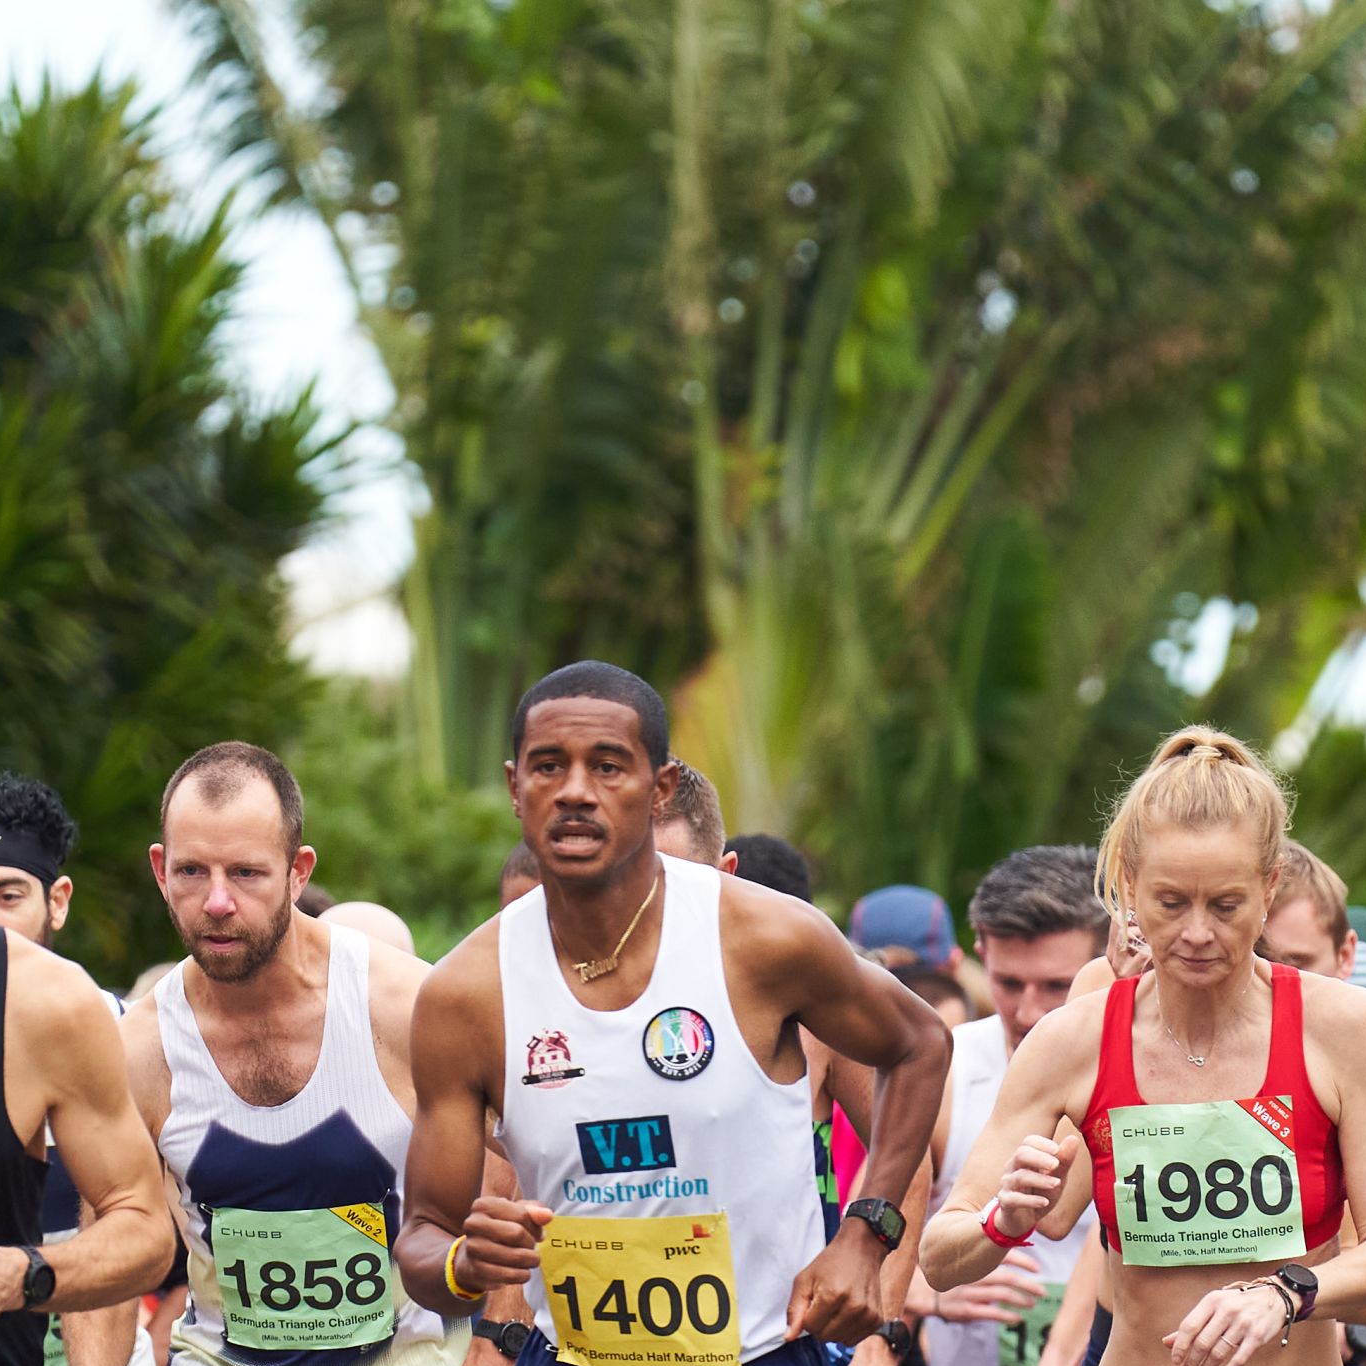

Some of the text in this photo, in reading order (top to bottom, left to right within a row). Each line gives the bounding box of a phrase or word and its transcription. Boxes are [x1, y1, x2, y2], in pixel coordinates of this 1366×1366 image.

[1252, 1101, 1291, 1138] Wave 3
[1122, 1126, 1185, 1138] CHUBB
[586, 1119, 670, 1169] V.T.
[563, 1175, 709, 1203] Construction
[1123, 1154, 1294, 1222] 1980
[221, 1227, 282, 1239] CHUBB
[346, 1209, 382, 1238] Wave 2
[1124, 1224, 1294, 1243] Bermuda Triangle Challenge
[551, 1238, 701, 1260] CHUBB pwc
[1160, 1246, 1258, 1258] (Mile, 10k, Half Marathon)
[223, 1252, 387, 1312] 1858
[552, 1274, 731, 1337] 1400
[230, 1310, 385, 1330] Bermuda Triangle Challenge
[316, 1333, 353, 1341] Marathon)
[589, 1350, 644, 1362] Bermuda
[647, 1352, 671, 1362] Half
[674, 1352, 734, 1363] Marathon
